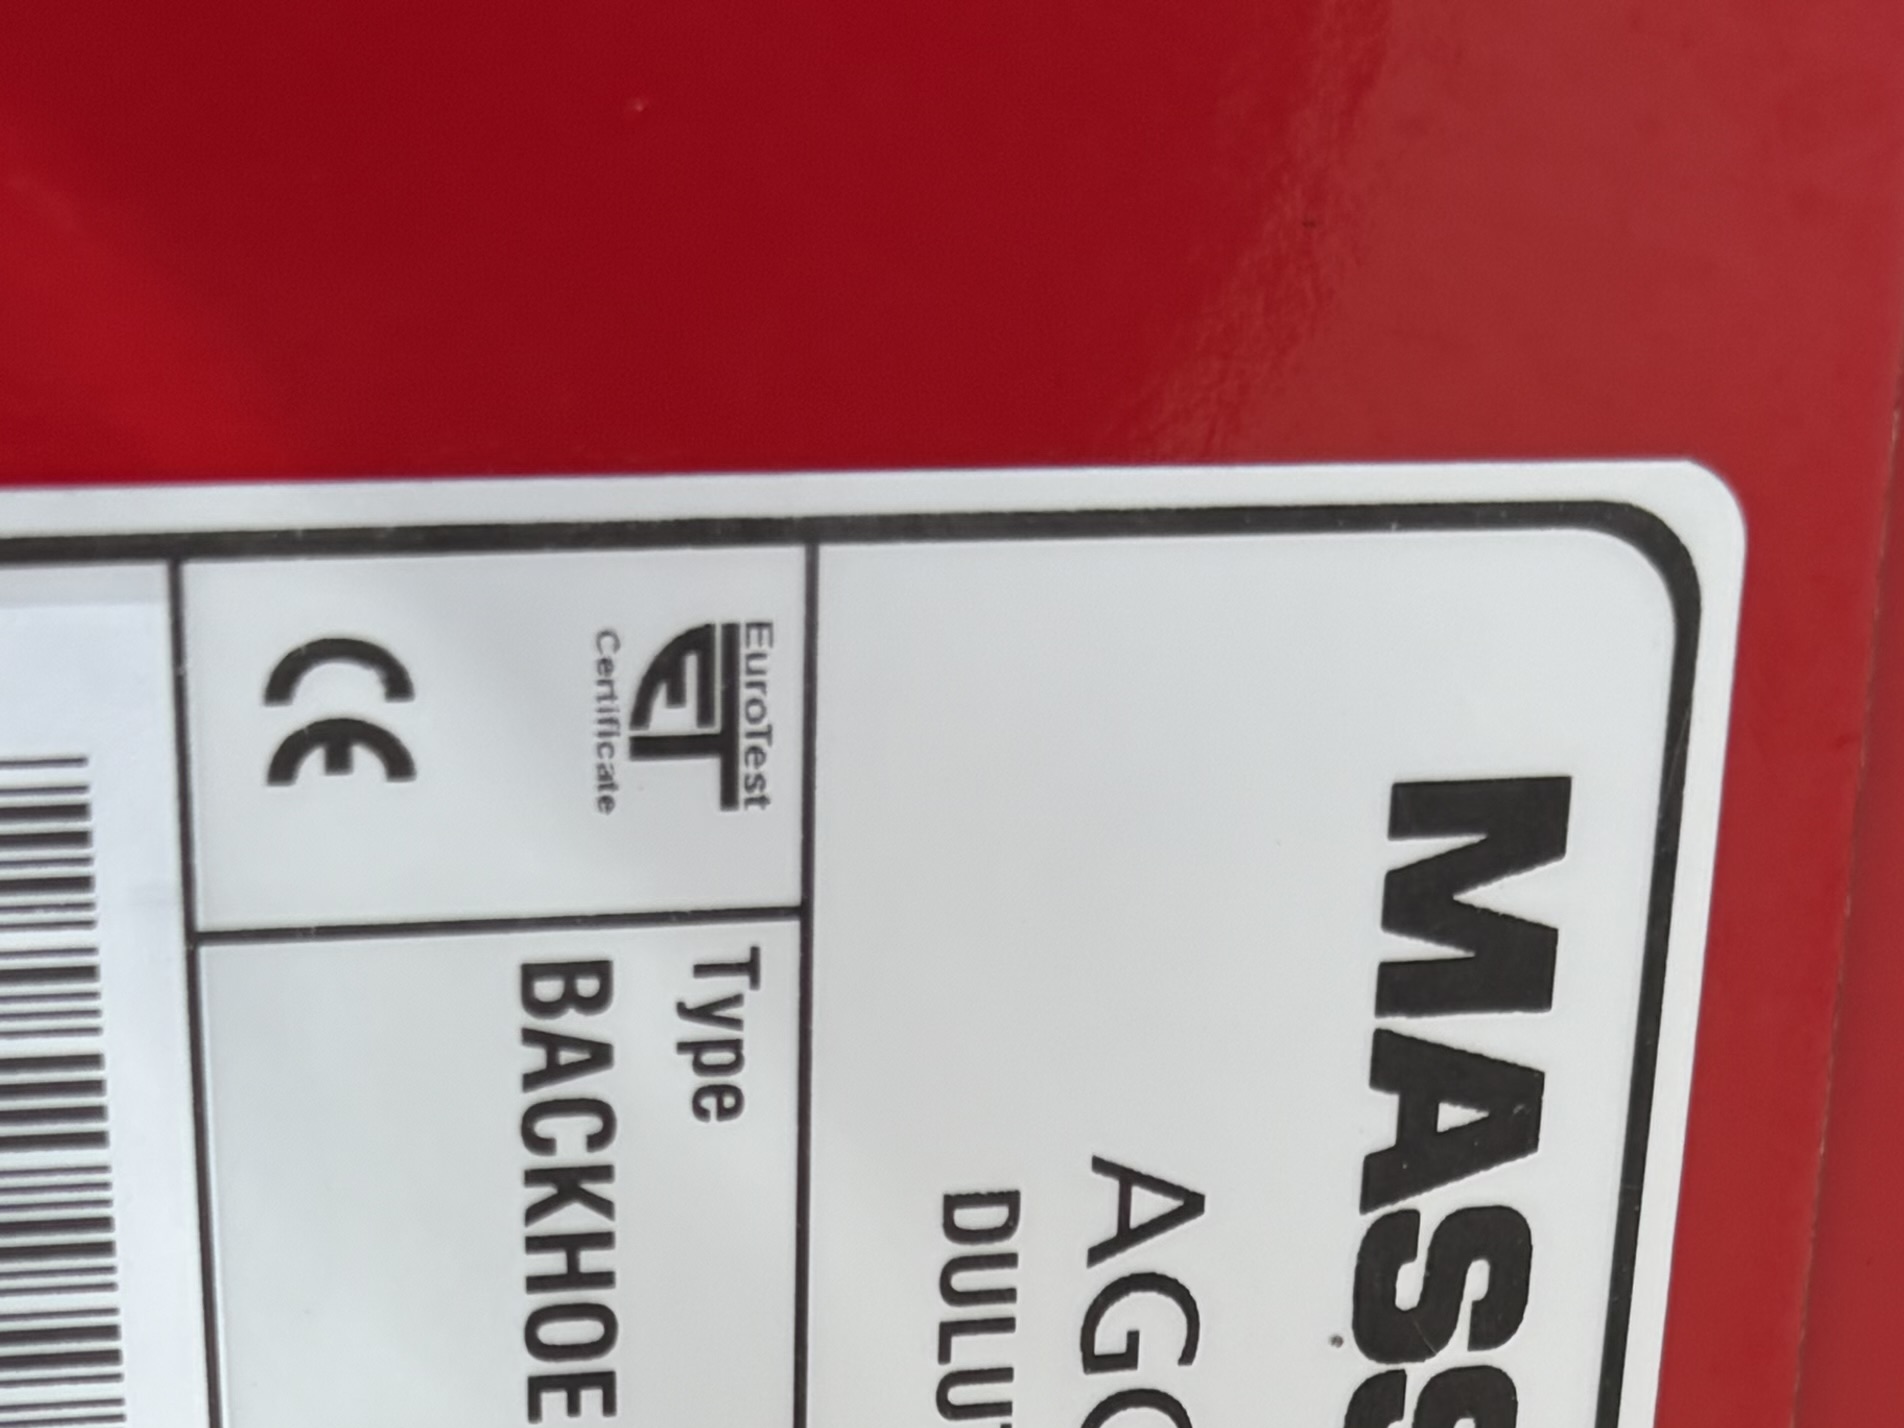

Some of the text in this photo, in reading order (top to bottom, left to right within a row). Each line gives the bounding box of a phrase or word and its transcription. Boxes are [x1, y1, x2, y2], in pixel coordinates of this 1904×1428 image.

[595, 628, 622, 815] Certificate
[741, 621, 774, 811] EuroTest
[675, 944, 762, 1123] Type
[519, 958, 619, 1424] BACKHOE
